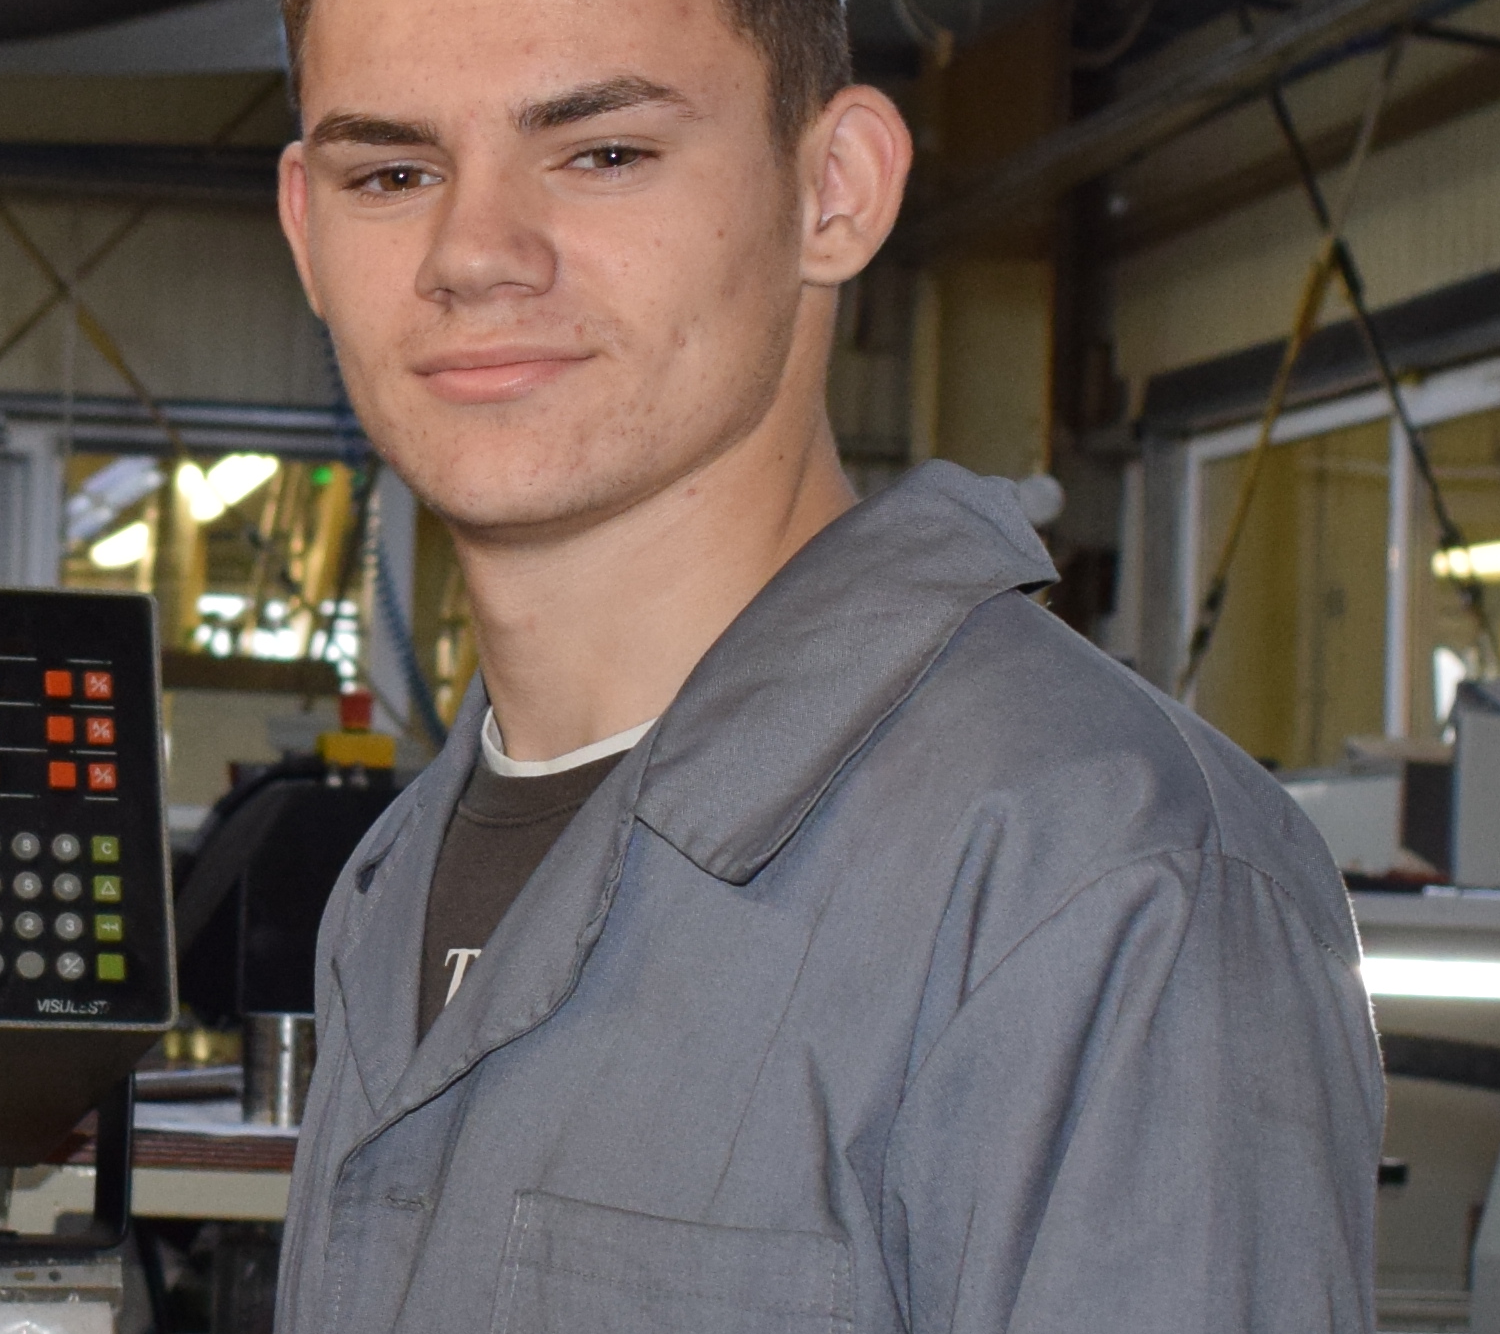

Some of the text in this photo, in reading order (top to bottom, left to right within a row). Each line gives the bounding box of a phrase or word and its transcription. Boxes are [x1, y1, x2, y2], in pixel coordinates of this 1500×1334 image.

[101, 842, 112, 855] C
[25, 918, 34, 930] 2
[65, 919, 75, 932] 3
